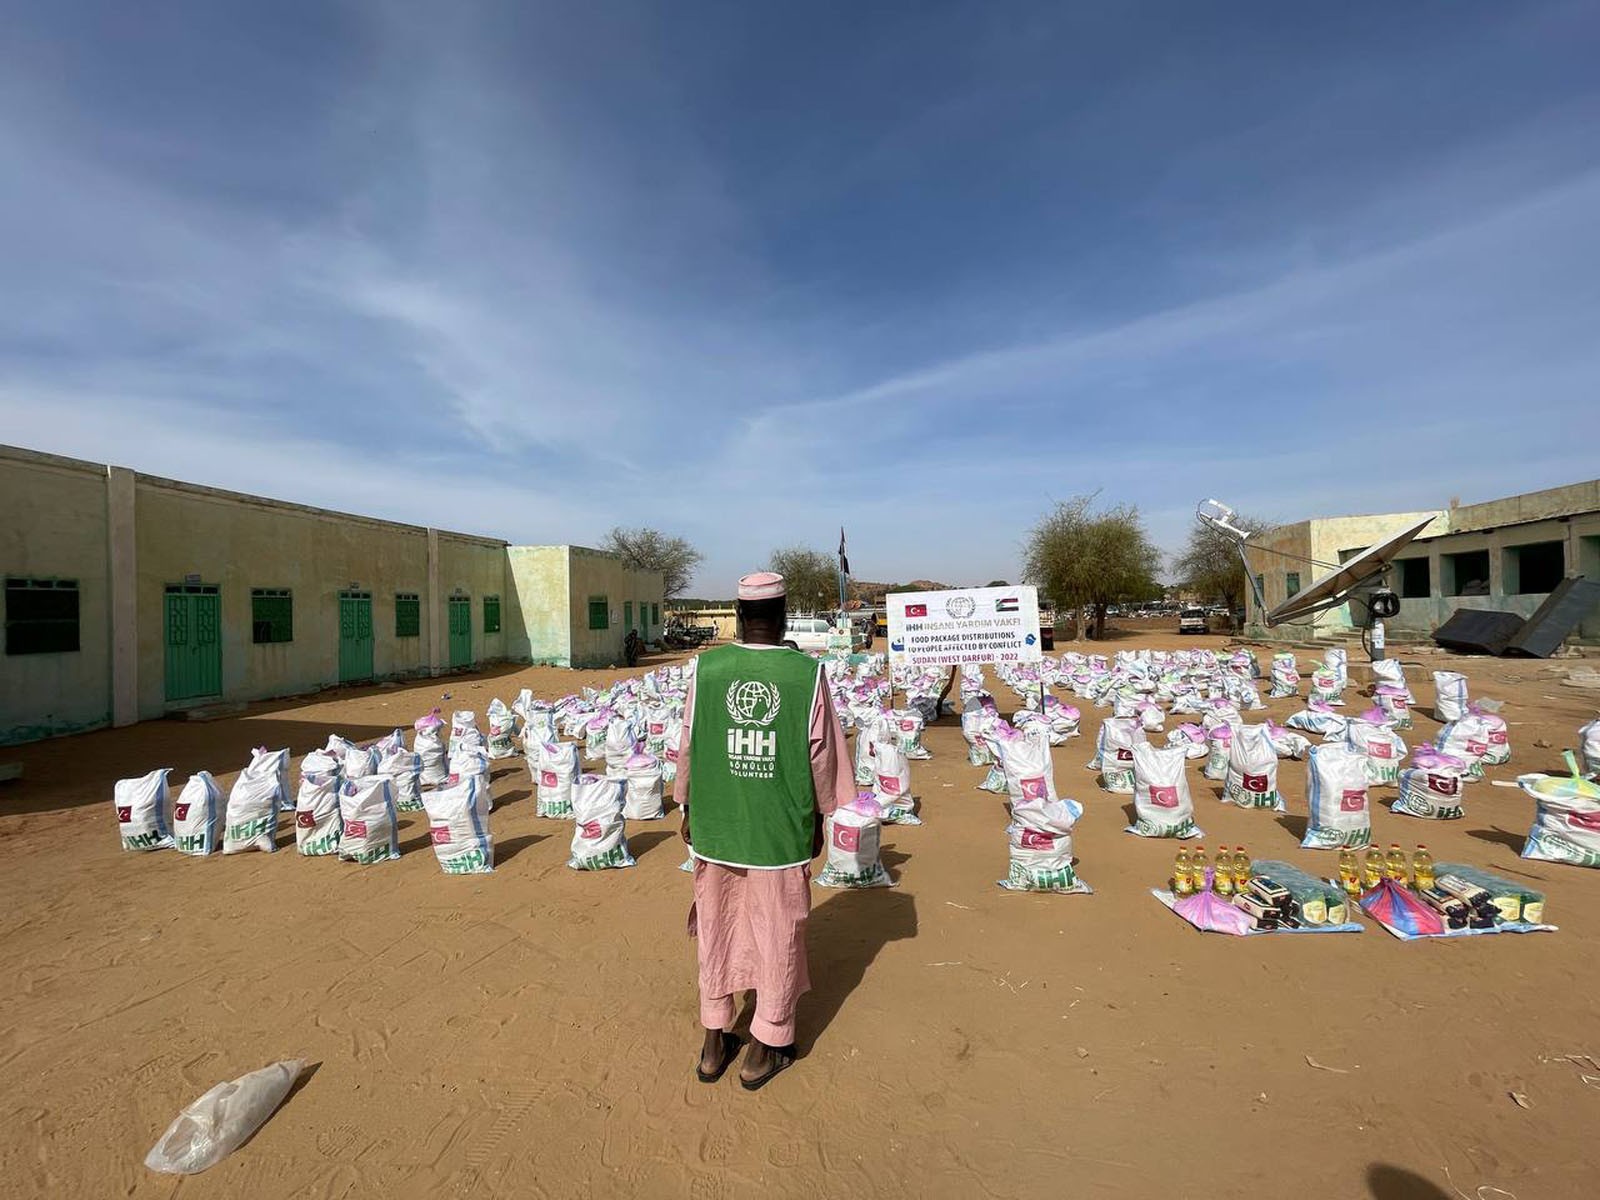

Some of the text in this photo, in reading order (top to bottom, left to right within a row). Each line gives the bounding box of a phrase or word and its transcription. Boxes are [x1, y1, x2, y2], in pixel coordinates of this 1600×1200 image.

[911, 631, 1015, 643] FOOD PACKAGE DISTRIBUTIONS
[917, 644, 942, 653] PEOPLE
[944, 642, 977, 651] AFFECTED
[978, 641, 989, 650] BY
[990, 640, 1022, 649] CONFLICT
[912, 655, 937, 664] SUDAN
[938, 654, 960, 664] (WEST
[962, 653, 995, 663] DARFUR)
[1000, 653, 1019, 661] 2022
